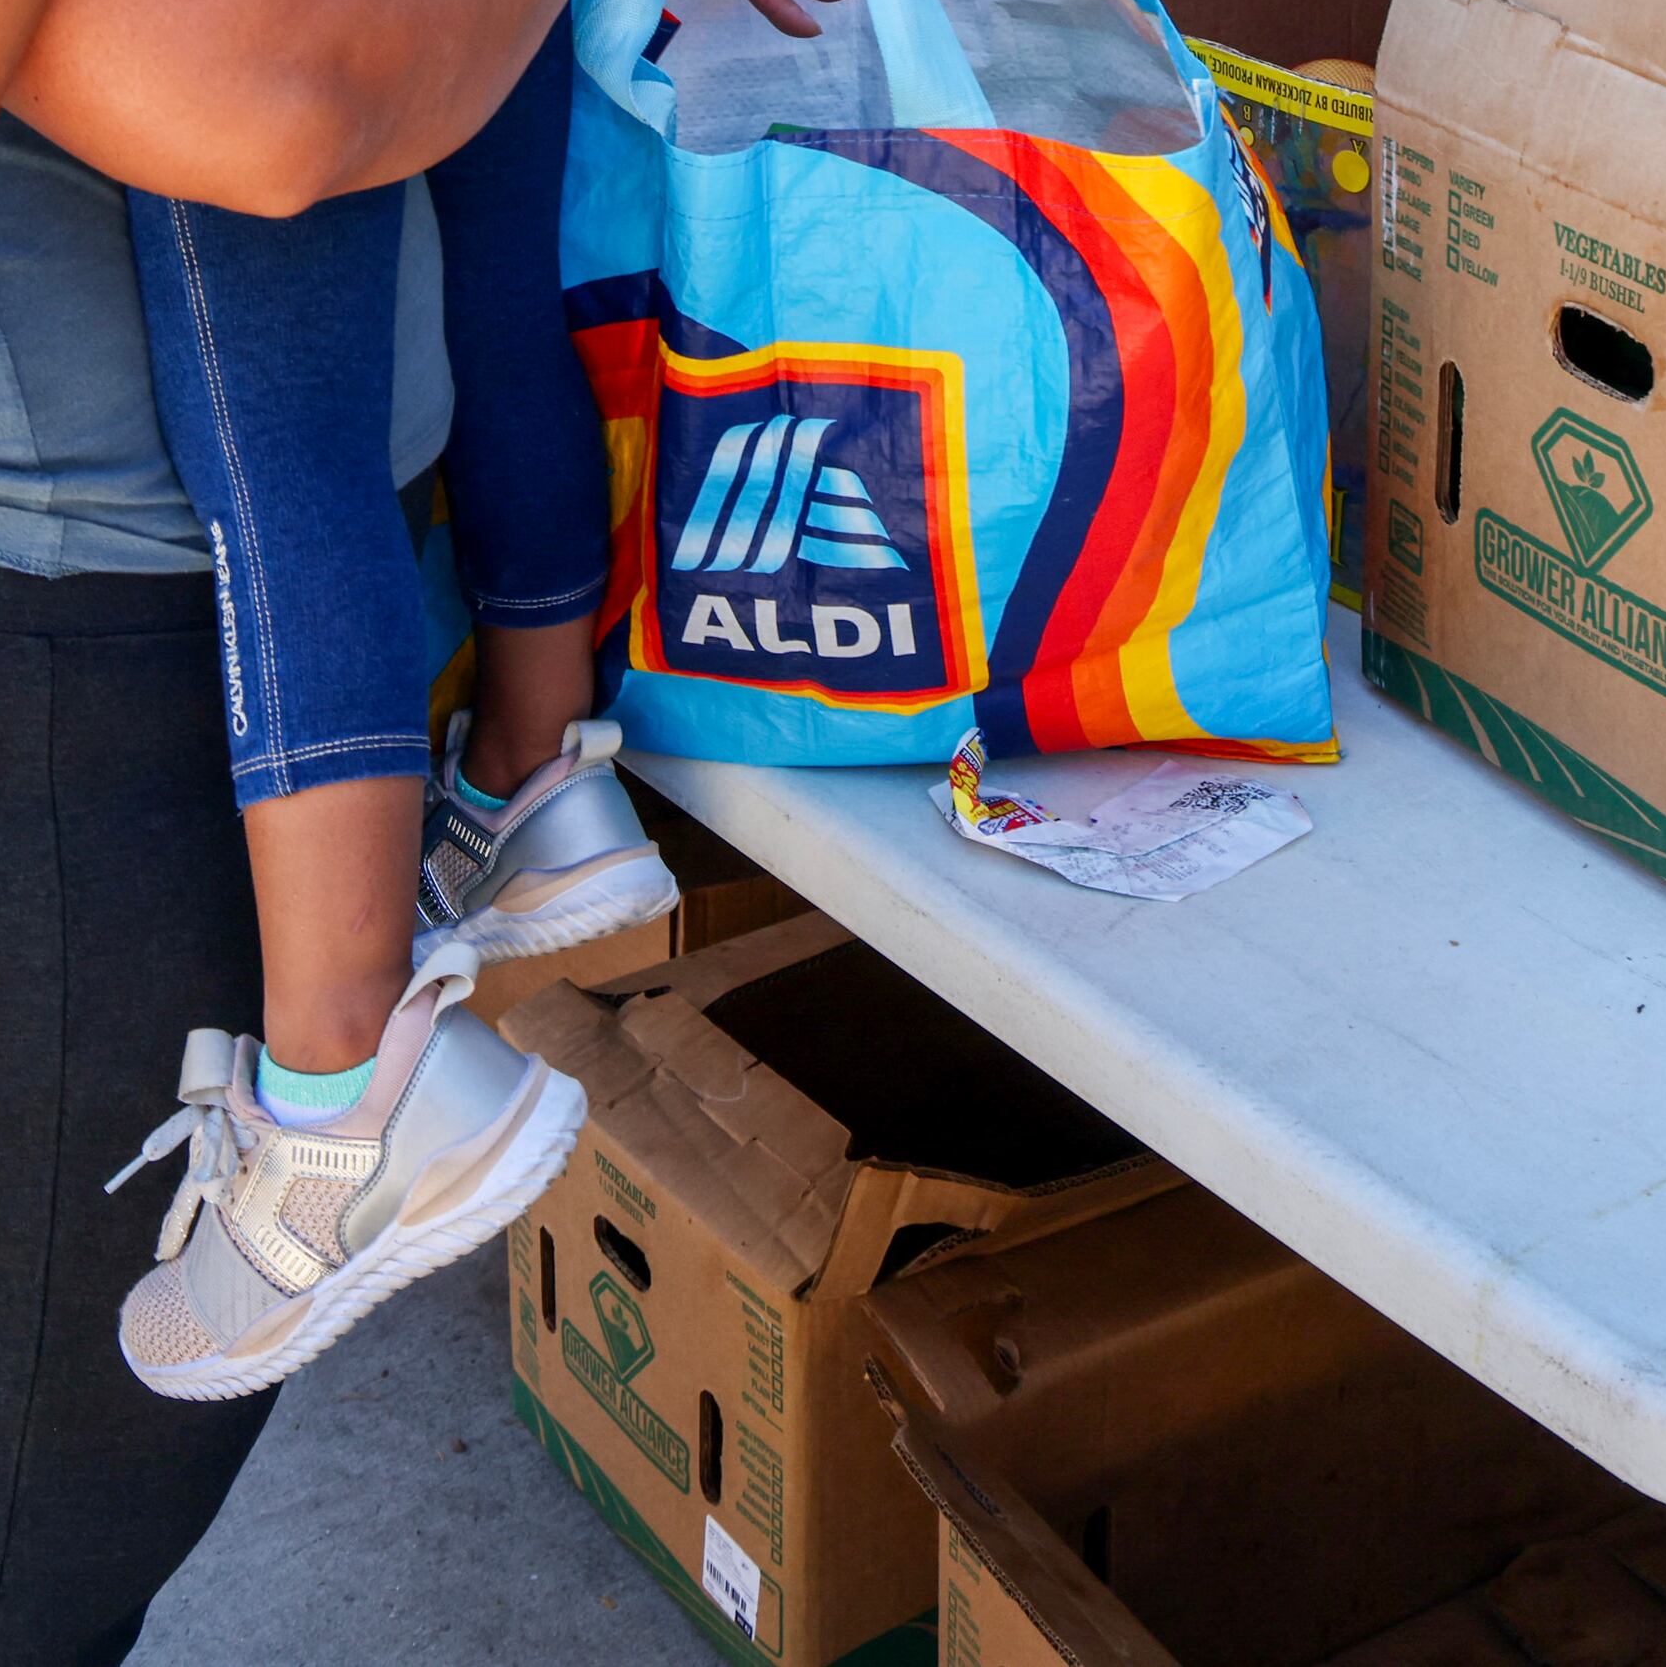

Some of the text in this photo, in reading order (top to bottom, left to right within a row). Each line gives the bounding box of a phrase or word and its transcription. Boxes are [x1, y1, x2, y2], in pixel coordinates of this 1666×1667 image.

[1208, 52, 1253, 85] PRODUCE,
[1255, 72, 1312, 105] ZUCKERMAN
[1315, 96, 1328, 111] BY
[1402, 146, 1435, 173] PEPPERS
[1449, 170, 1485, 200] VARIETY
[1463, 202, 1494, 230] GREEN
[1462, 229, 1480, 250] RED
[1461, 255, 1499, 287] YELLOW
[1554, 220, 1666, 295] VEGETABLES
[1560, 258, 1645, 313] 1-1/9 BUSHEL
[1483, 521, 1575, 616] GROWER
[680, 594, 916, 658] ALDI
[1497, 573, 1535, 604] SOLUTION
[1535, 597, 1553, 615] FOR
[1553, 607, 1576, 629] YOUR
[1576, 622, 1600, 646] FRUIT
[1601, 638, 1620, 657] AND
[594, 1150, 657, 1220] VEGETABLES
[565, 1330, 617, 1407] GROWER
[619, 1387, 689, 1478] ALLIANCE
